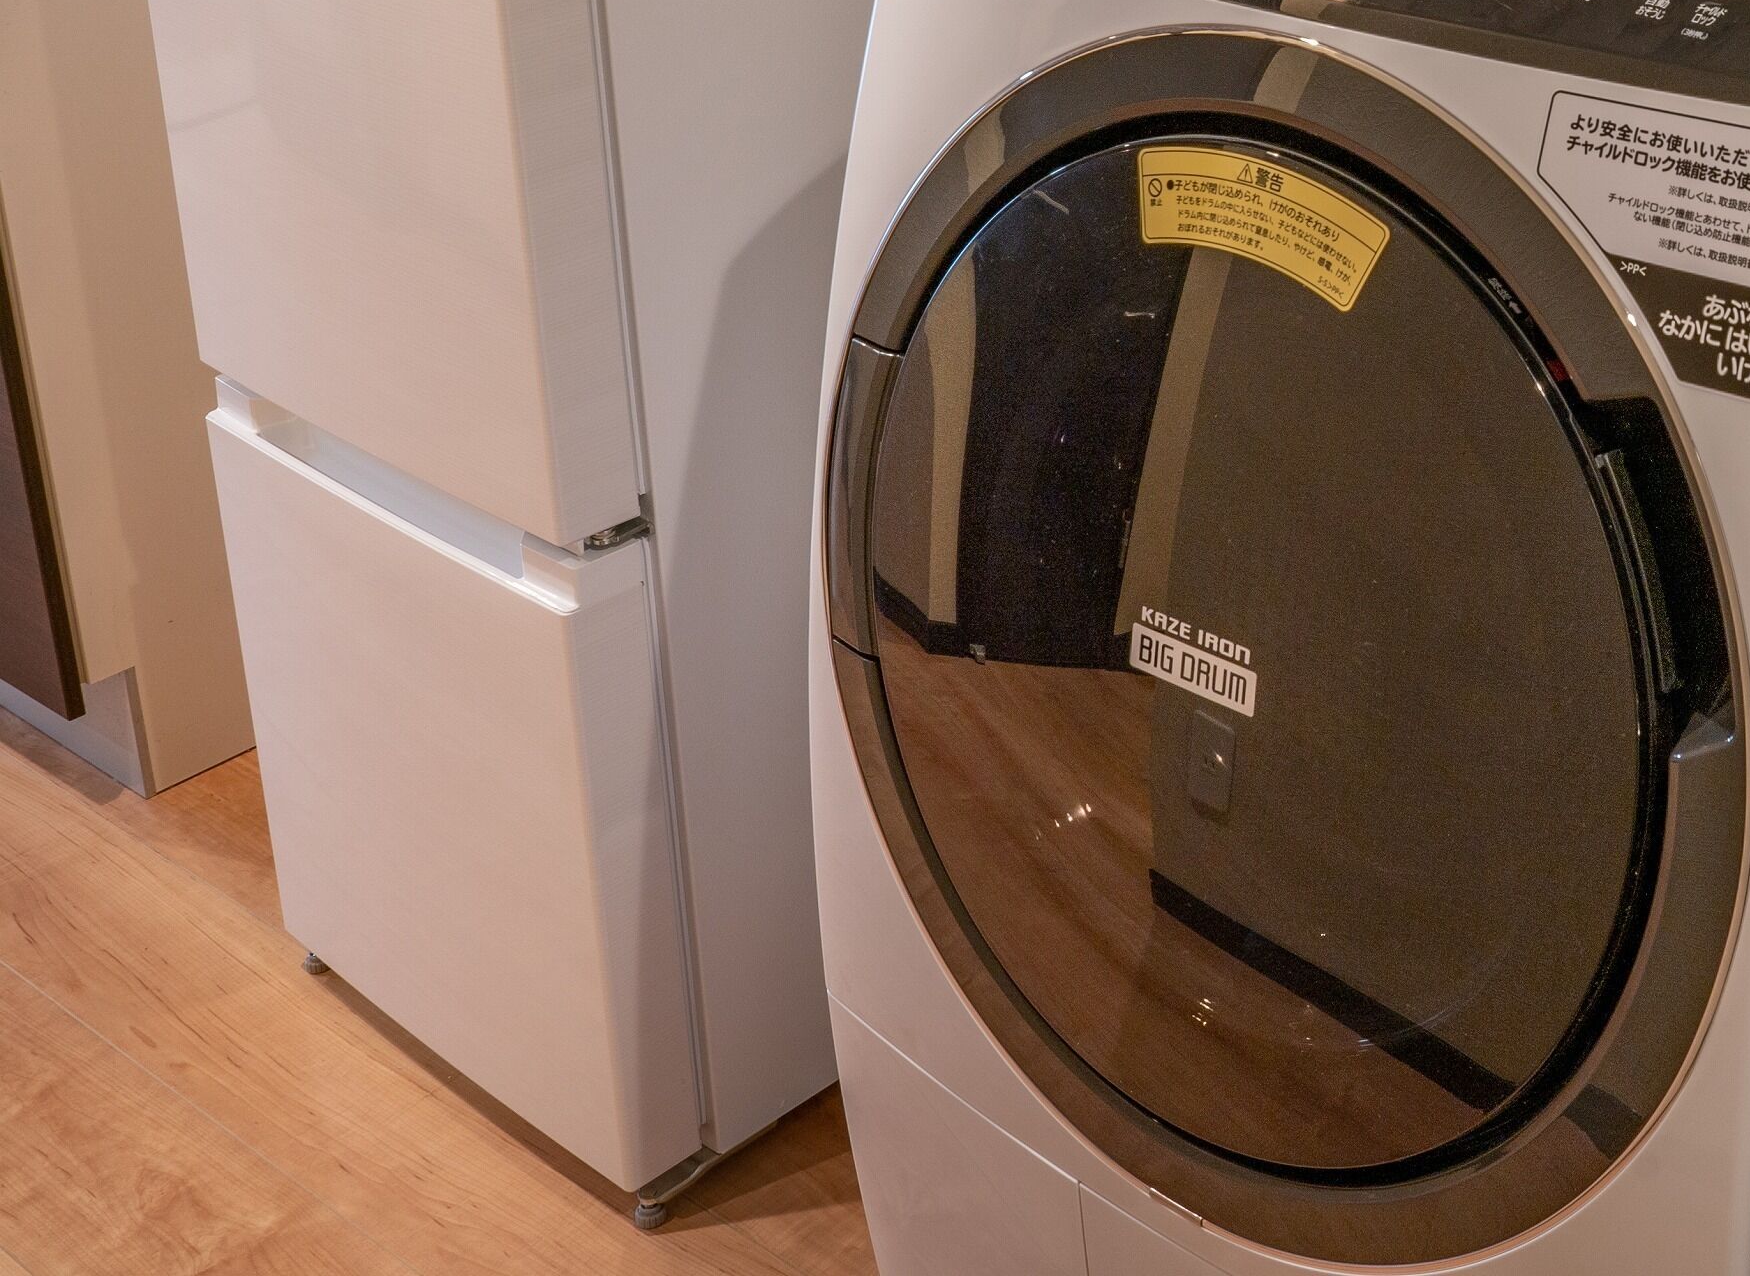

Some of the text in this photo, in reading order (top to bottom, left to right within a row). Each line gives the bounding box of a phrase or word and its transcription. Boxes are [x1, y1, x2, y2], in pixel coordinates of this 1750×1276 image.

[1635, 6, 1666, 20] おそうじ
[1691, 14, 1717, 27] ロック
[1255, 167, 1284, 193] 警告
[1177, 223, 1264, 251] おぼれるおそれがあります。
[1658, 310, 1721, 347] なかに
[1141, 605, 1251, 665] KAZE IRON
[1139, 634, 1247, 705] BIG DRUM
